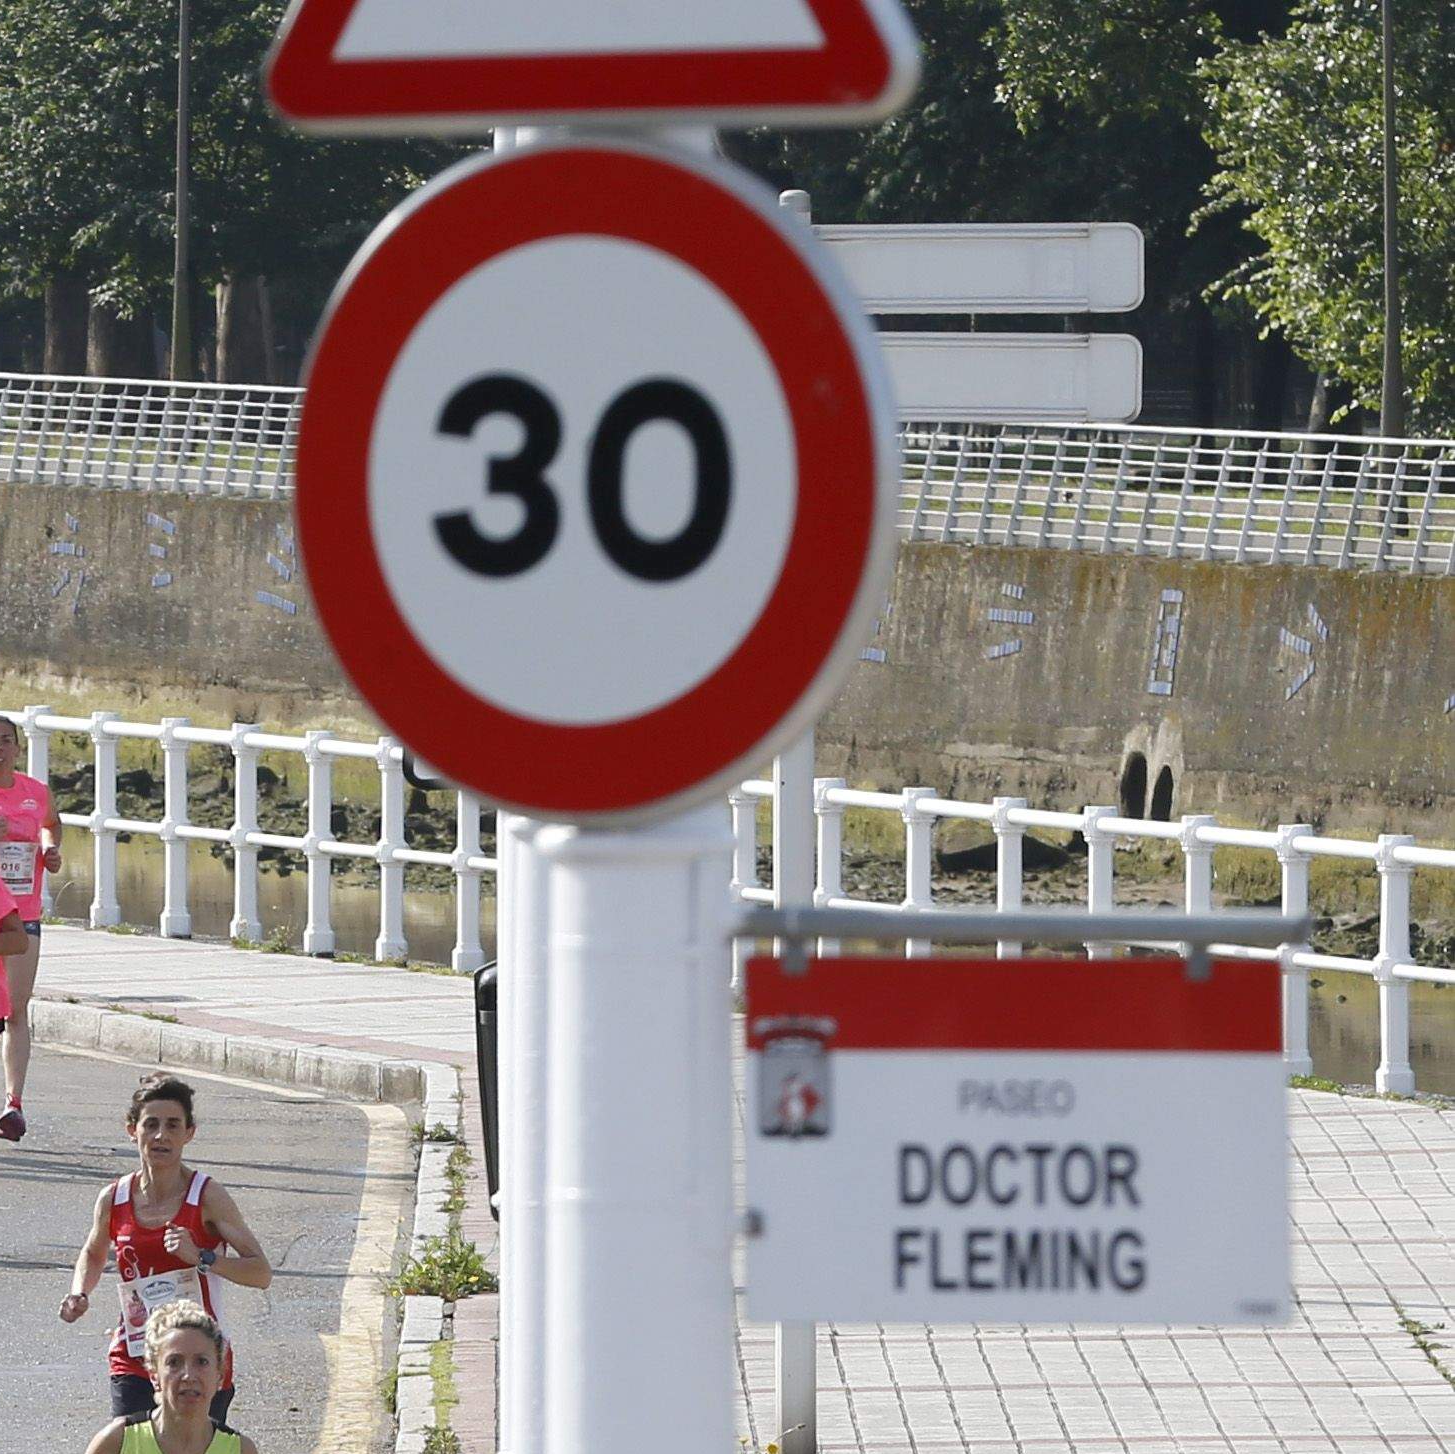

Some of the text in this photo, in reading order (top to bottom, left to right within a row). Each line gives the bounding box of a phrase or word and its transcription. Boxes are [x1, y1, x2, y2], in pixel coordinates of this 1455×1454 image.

[433, 370, 733, 585] 30
[958, 1079, 1076, 1115] PASEO
[897, 1142, 1141, 1206] DOCTOR
[894, 1228, 1147, 1293] FLEMING
